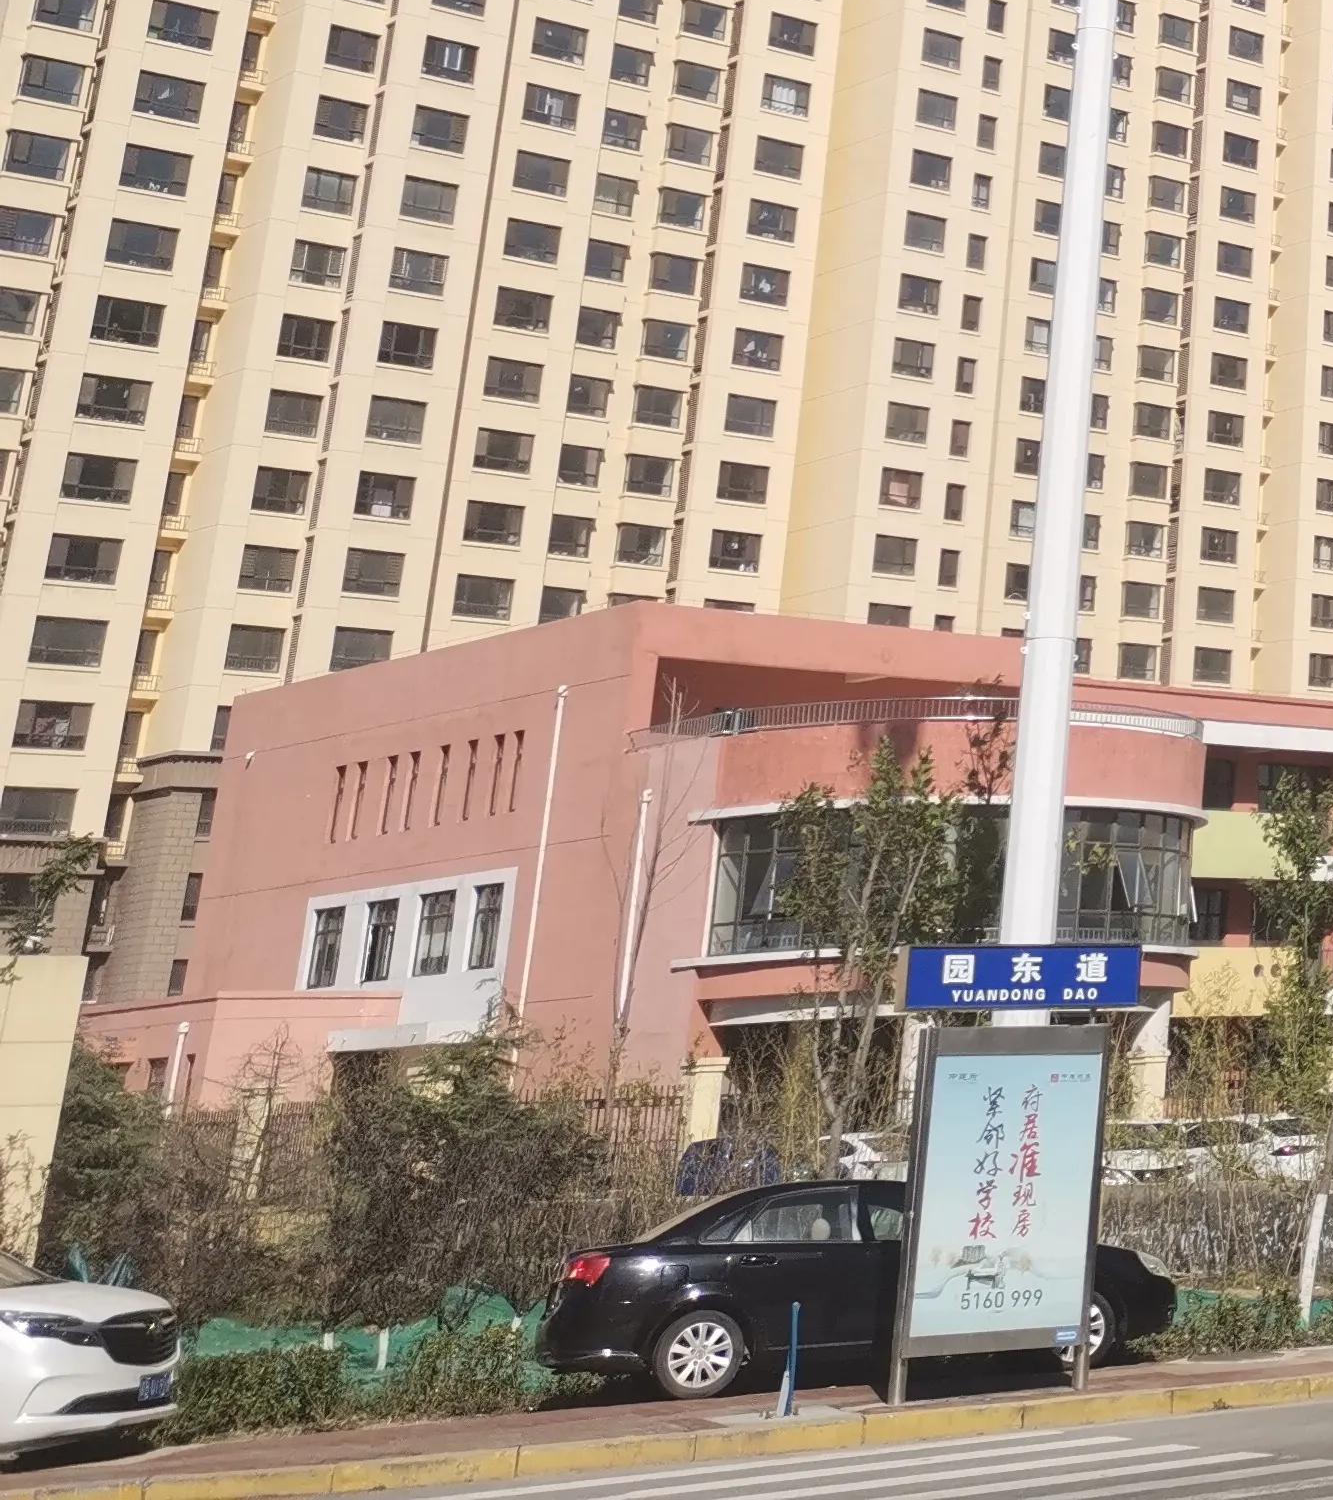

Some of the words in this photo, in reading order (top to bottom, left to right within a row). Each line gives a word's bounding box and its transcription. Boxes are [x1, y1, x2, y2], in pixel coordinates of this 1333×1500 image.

[942, 952, 1108, 984] 园东道
[952, 988, 1046, 1002] YUANDONG
[1063, 987, 1098, 1000] DAO
[968, 1086, 1005, 1240] 紧邻好学校
